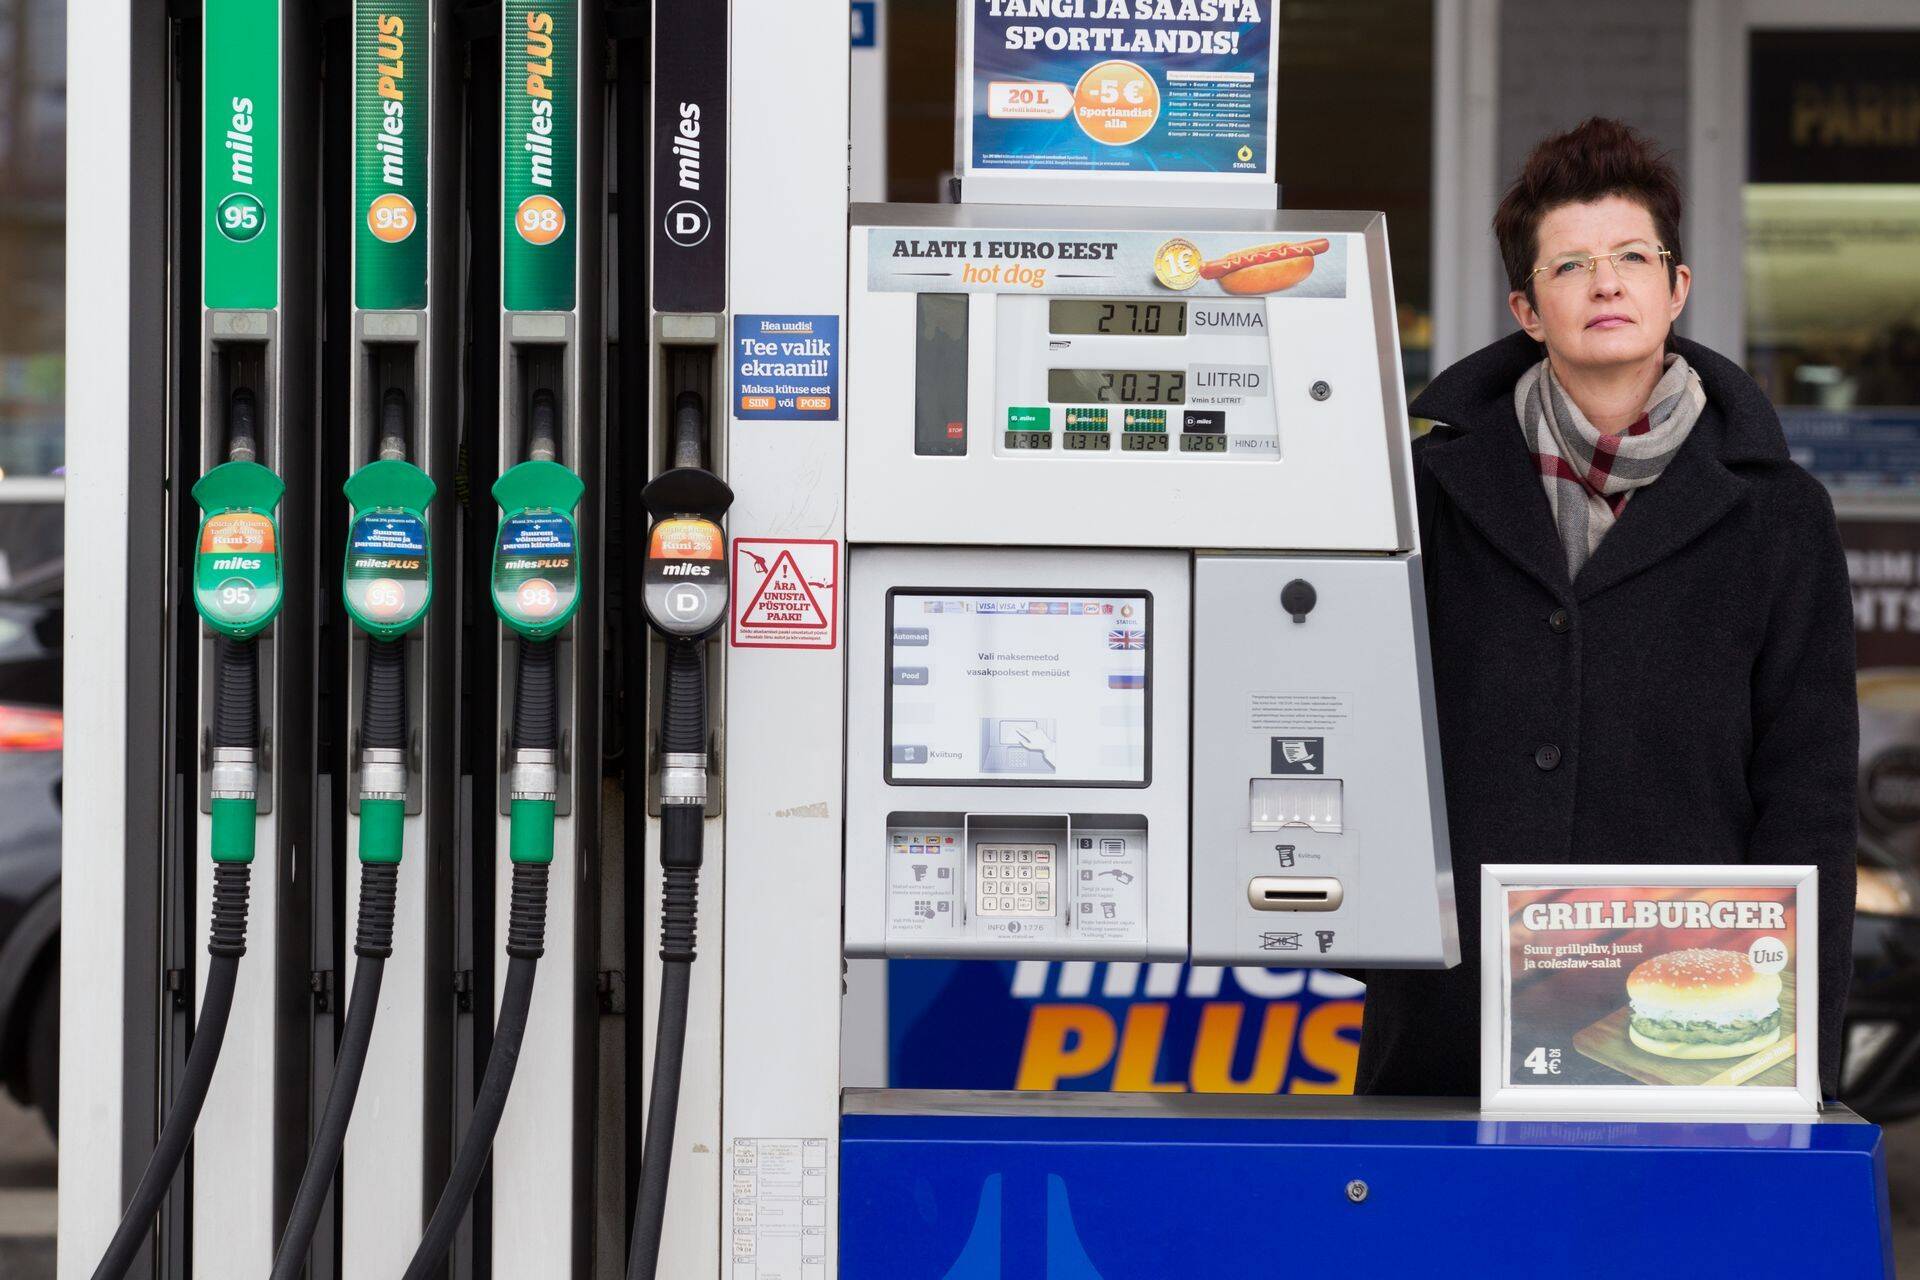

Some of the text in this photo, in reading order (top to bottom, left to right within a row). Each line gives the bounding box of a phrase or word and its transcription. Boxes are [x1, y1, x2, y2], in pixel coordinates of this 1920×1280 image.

[985, 0, 1085, 18] TANGI
[1090, 0, 1131, 20] JA
[1005, 26, 1240, 55] SPORTLANDIS!
[376, 14, 404, 186] milesPLUS
[524, 12, 553, 187] milesPLUS
[1008, 89, 1048, 104] 20 L
[1089, 80, 1144, 104] -5 €
[1080, 107, 1152, 118] Sportlandist
[1104, 118, 1127, 128] alla
[226, 97, 254, 185] miles
[672, 102, 700, 191] miles
[224, 206, 258, 229] 95
[376, 207, 408, 230] 95
[523, 208, 558, 232] 98
[676, 214, 701, 234] D
[892, 240, 1118, 260] ALATI 1 EURO EEST
[962, 264, 1046, 288] hot dog
[761, 322, 812, 330] Hea uudis!
[1100, 304, 1184, 333] 27.01
[1195, 312, 1264, 328] SUMMA
[742, 339, 830, 356] Tee valik
[741, 360, 828, 376] ekraanil!
[1098, 374, 1184, 402] 20.32
[1197, 372, 1260, 388] LIITRID
[742, 384, 830, 394] Maksa kütuse eest
[749, 398, 826, 408] SIIN või POES
[1072, 435, 1109, 449] 1.319
[1130, 436, 1168, 450] 1.329
[1188, 437, 1226, 450] 1.269
[1234, 440, 1257, 448] HIND
[213, 556, 261, 570] miles
[355, 558, 419, 569] milesPLUS
[505, 559, 569, 569] milesPLUS
[662, 563, 711, 576] miles
[774, 581, 796, 590] ÄRA
[222, 587, 250, 604] 95
[372, 589, 397, 606] 95
[522, 588, 551, 606] 98
[676, 593, 699, 612] D
[764, 592, 806, 601] UNUSTA
[759, 601, 810, 611] PÜSTOLIT
[767, 613, 802, 621] PAAKI!
[978, 652, 1060, 662] Vali maksemeetod
[901, 672, 920, 680] Pood
[967, 668, 1070, 678] vasakpoolsest menüüst
[930, 751, 963, 760] Kviitung
[1522, 900, 1786, 931] GRILLBURGER
[1524, 943, 1643, 956] Suur grillpihv, juust
[1753, 948, 1784, 964] Uus
[1524, 958, 1622, 970] ja coleslaw-salat
[1013, 1002, 1366, 1096] PLUS
[1524, 1048, 1548, 1075] 4
[1548, 1059, 1561, 1075] €
